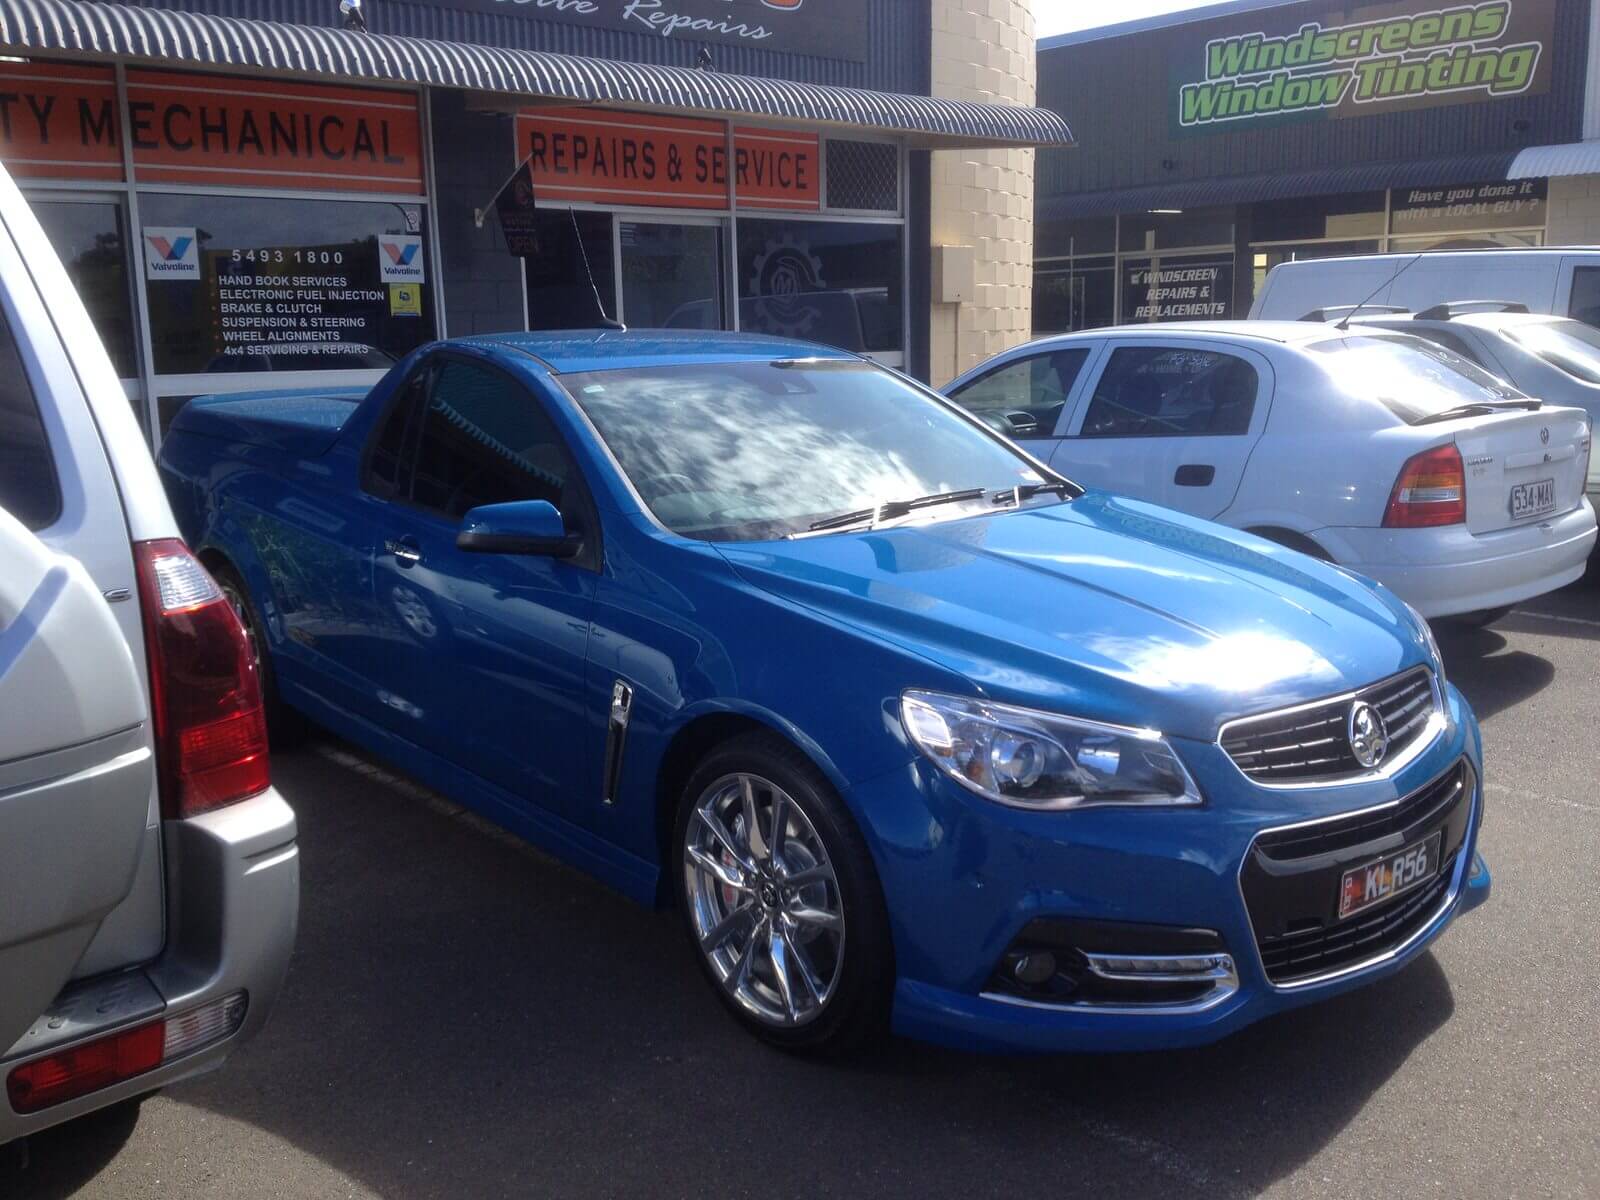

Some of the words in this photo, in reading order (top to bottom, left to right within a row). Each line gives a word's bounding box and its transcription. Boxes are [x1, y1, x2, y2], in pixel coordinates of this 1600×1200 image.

[623, 0, 772, 39] Repairs
[1207, 3, 1508, 79] Windscreens
[1182, 71, 1350, 124] Window
[1355, 45, 1539, 99] Tinting
[78, 97, 404, 163] MECHANICAL
[530, 132, 656, 181] REPAIRS
[667, 144, 682, 182] &
[695, 145, 808, 190] SERVICE
[1408, 190, 1443, 203] Have
[1446, 189, 1475, 203] you
[1478, 184, 1516, 197] done
[1520, 181, 1533, 194] it
[1447, 202, 1489, 217] LOCAL
[1493, 200, 1526, 214] GUY
[231, 249, 284, 263] 5493
[294, 250, 343, 264] 1800
[151, 262, 195, 272] Valvoline
[384, 267, 421, 275] Valvoline
[218, 275, 253, 286] HAND
[255, 275, 290, 287] BOOK
[292, 276, 347, 287] SERVICES
[1143, 268, 1218, 284] WINDSCREEN
[219, 289, 294, 300] ELECTRONIC
[296, 290, 326, 301] FUEL
[328, 290, 385, 301] INJECTION
[1146, 286, 1198, 300] REPAIRS
[1200, 286, 1210, 298] &
[221, 303, 262, 314] BRAKE
[265, 303, 274, 314] &
[276, 303, 322, 314] CLUTCH
[1135, 302, 1226, 318] REPLACEMENTS
[222, 317, 297, 328] SUSPENSION
[299, 317, 308, 328] &
[311, 317, 366, 328] STEERING
[223, 331, 265, 341] WHEEL
[267, 331, 341, 341] ALIGNMENTS
[224, 345, 244, 356] 4x4
[247, 345, 309, 355] SERVICING
[311, 344, 320, 355] &
[324, 344, 369, 354] REPAIRS
